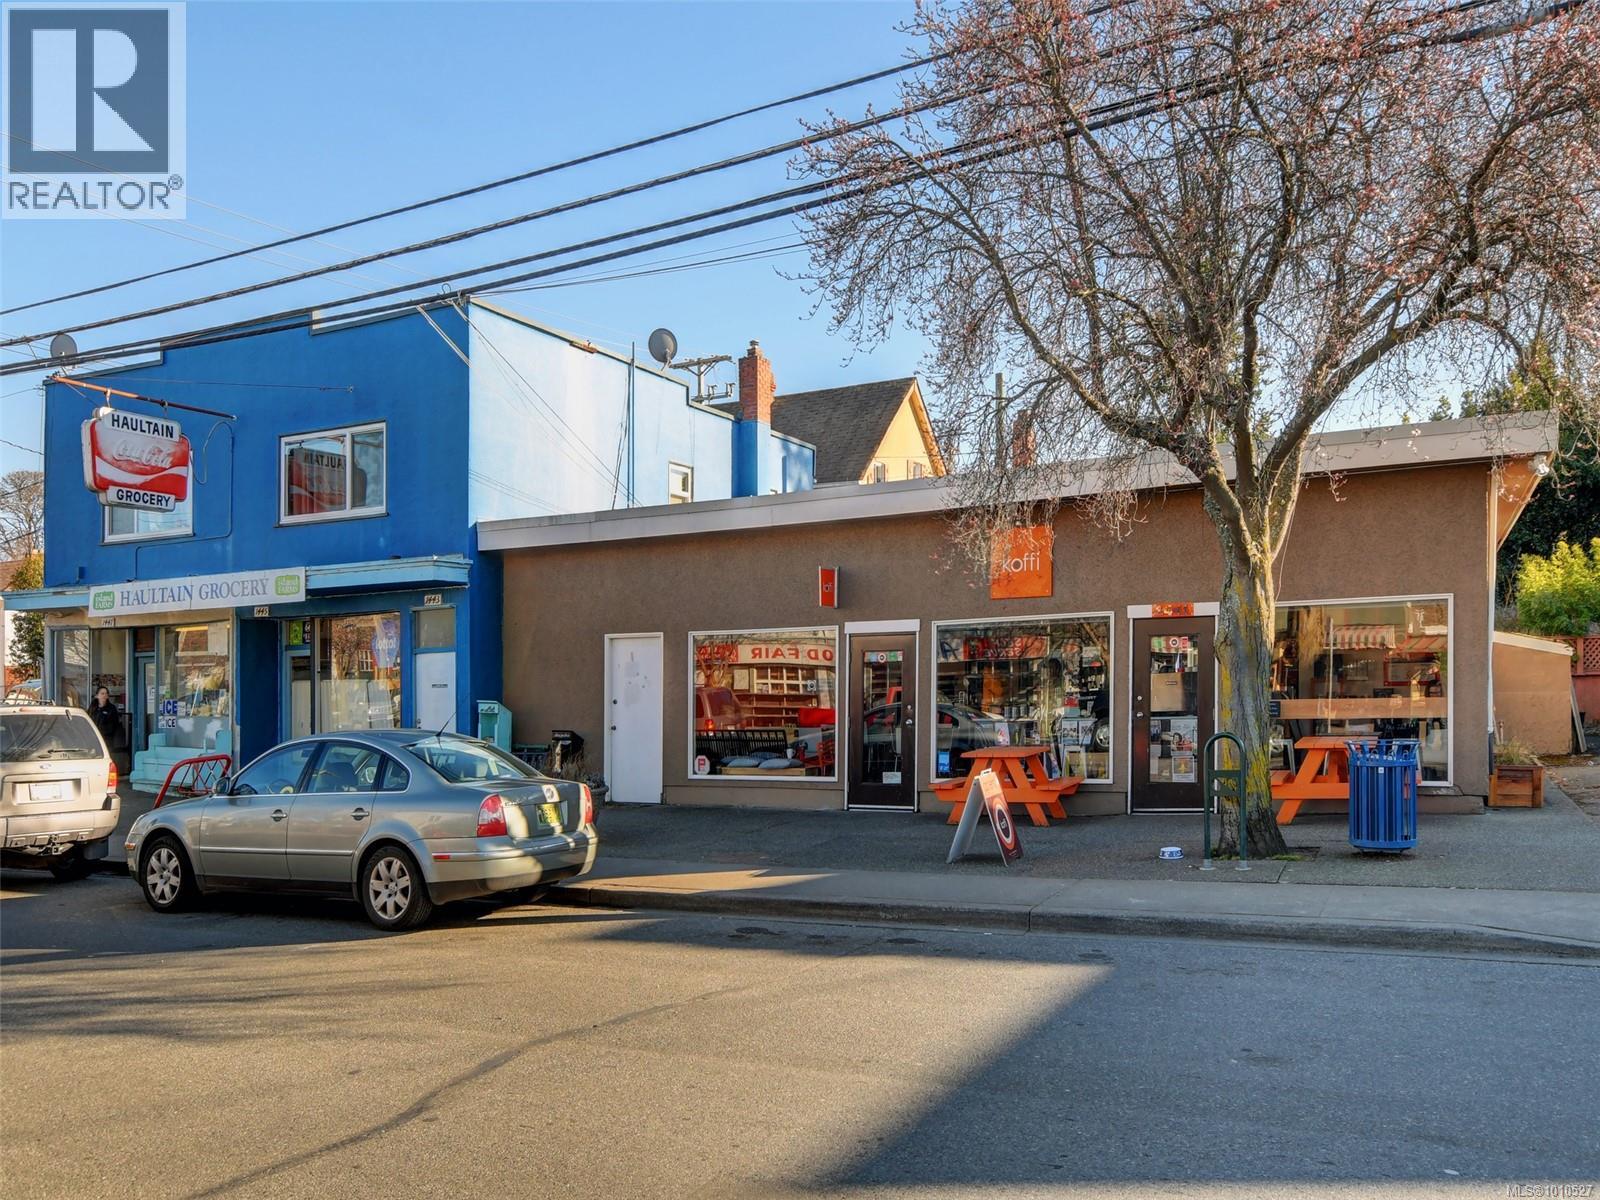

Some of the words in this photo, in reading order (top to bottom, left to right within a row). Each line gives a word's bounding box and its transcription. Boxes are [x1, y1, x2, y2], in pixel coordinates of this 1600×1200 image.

[111, 413, 174, 439] HAULTAIN
[116, 488, 171, 507] GROCERY
[1002, 551, 1040, 573] koffi
[120, 584, 194, 607] HAULTAIN
[199, 578, 269, 600] GROCERY
[162, 700, 178, 715] ICE
